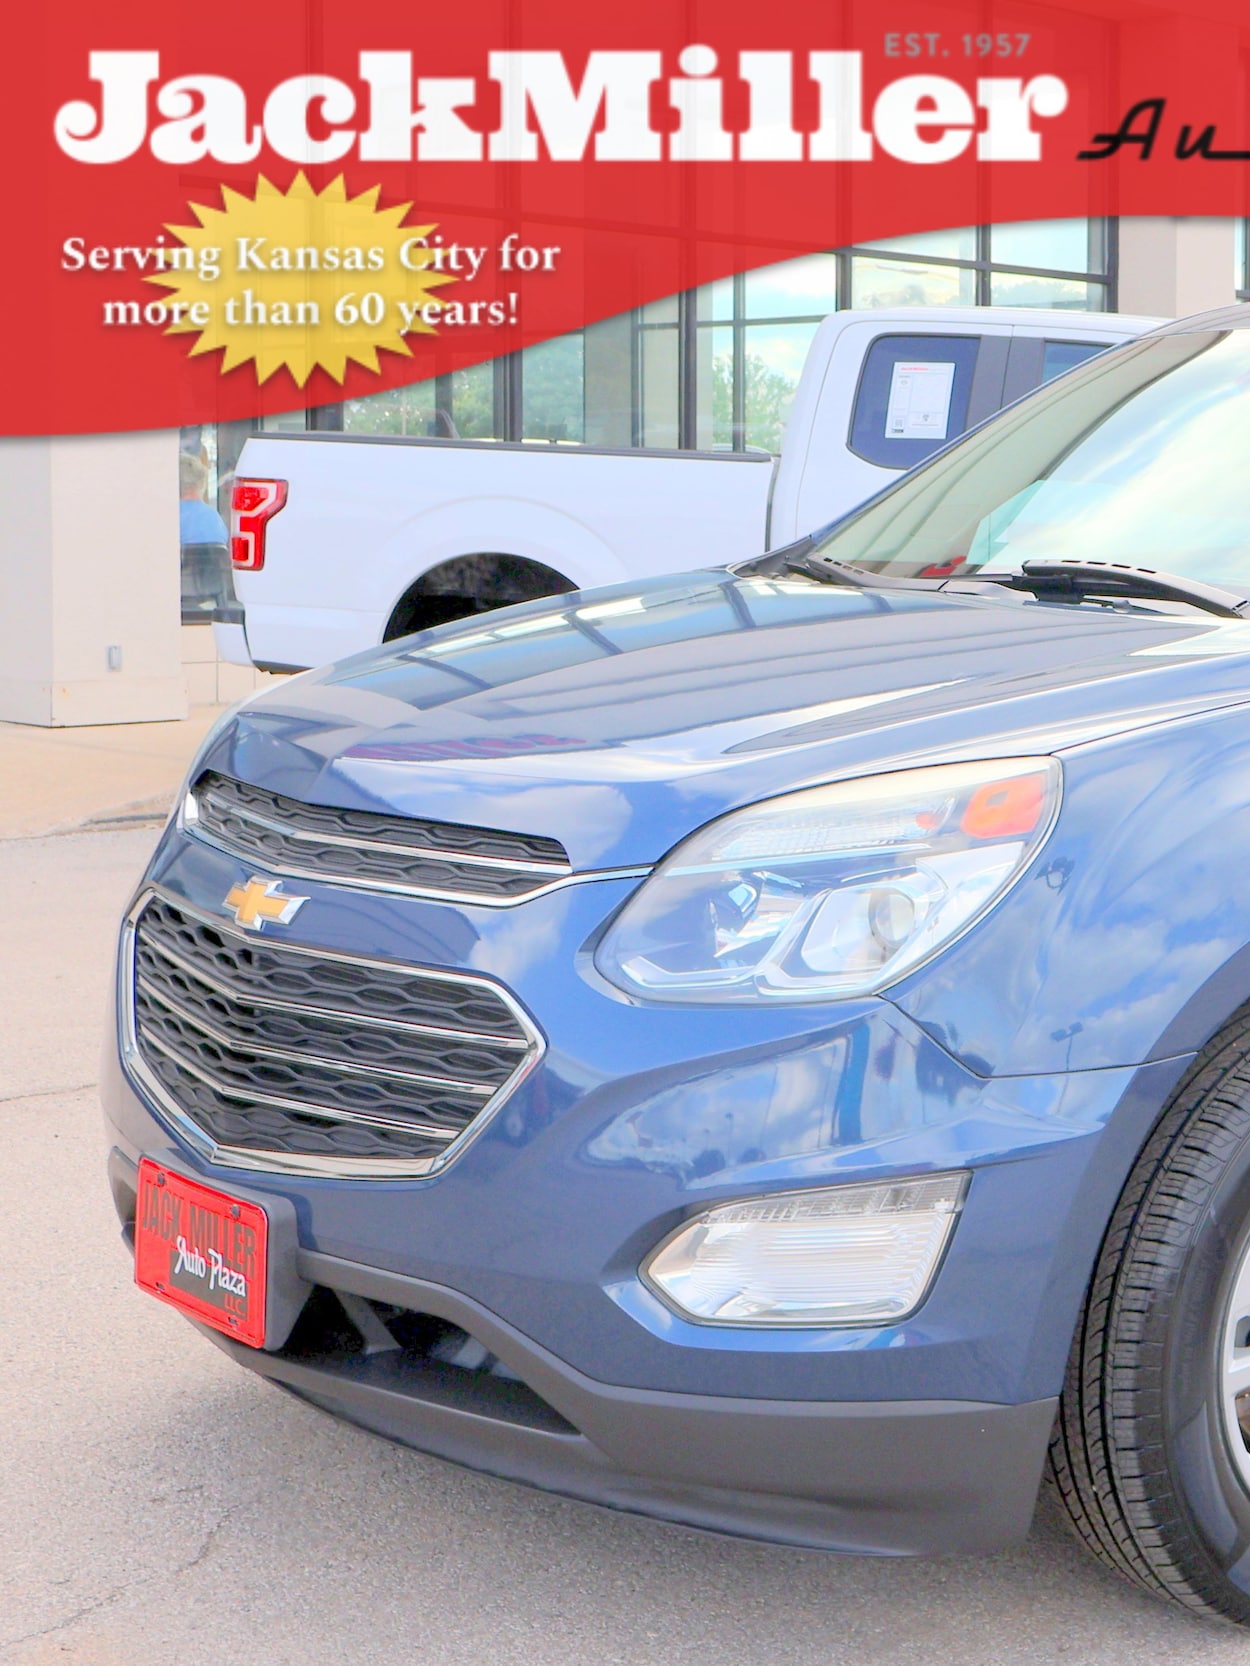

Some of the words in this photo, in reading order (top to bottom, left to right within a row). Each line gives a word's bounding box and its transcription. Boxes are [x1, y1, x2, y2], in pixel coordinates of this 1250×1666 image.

[142, 1183, 183, 1243] JACK
[189, 1203, 256, 1282] MILLER
[174, 1235, 206, 1279] Auto
[207, 1247, 246, 1297] Plaza
[224, 1293, 246, 1315] LLC
